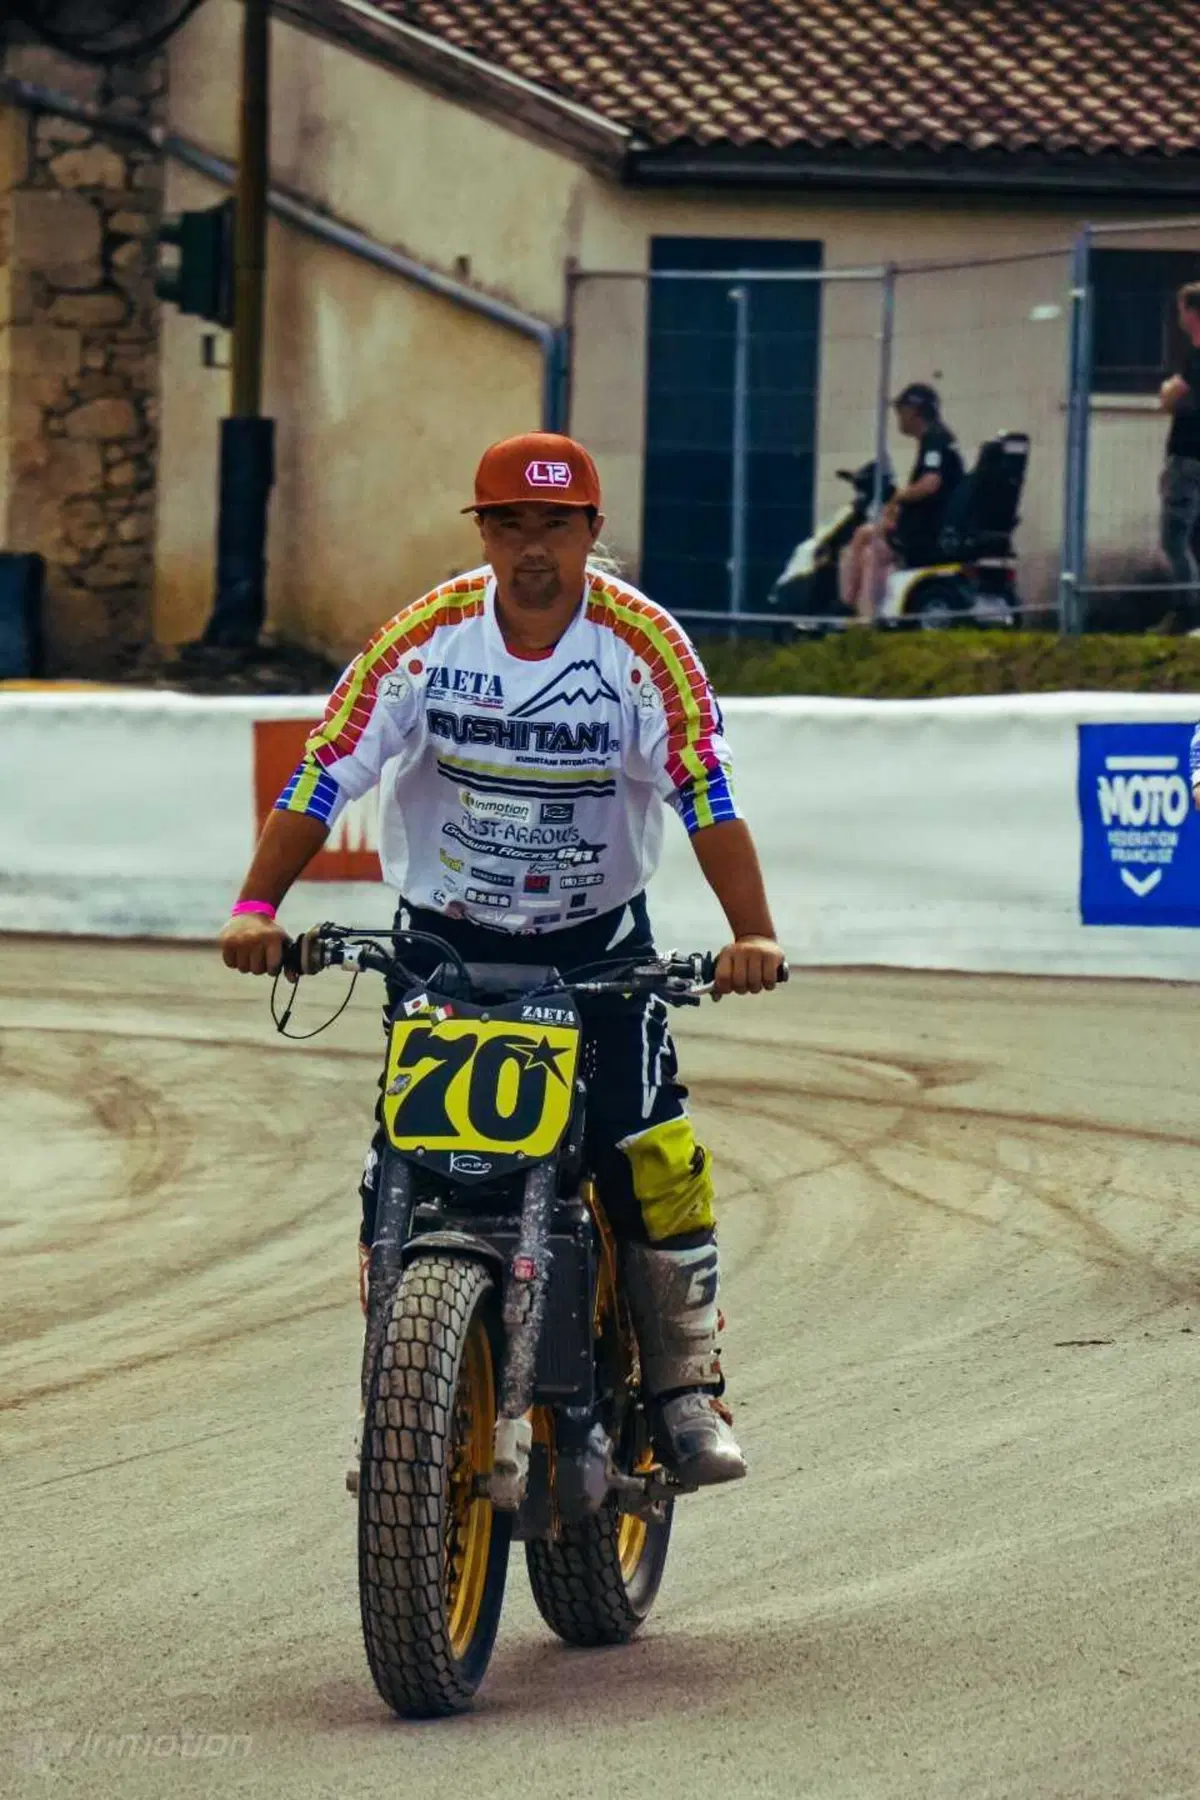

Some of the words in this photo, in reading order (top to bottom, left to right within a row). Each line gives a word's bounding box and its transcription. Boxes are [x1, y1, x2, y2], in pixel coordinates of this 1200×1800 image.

[532, 464, 567, 483] L12
[426, 666, 504, 697] ZAETA
[1097, 774, 1189, 827] MOTO
[499, 848, 555, 862] Racing
[521, 1005, 576, 1022] ZAETA
[393, 1027, 550, 1142] 70
